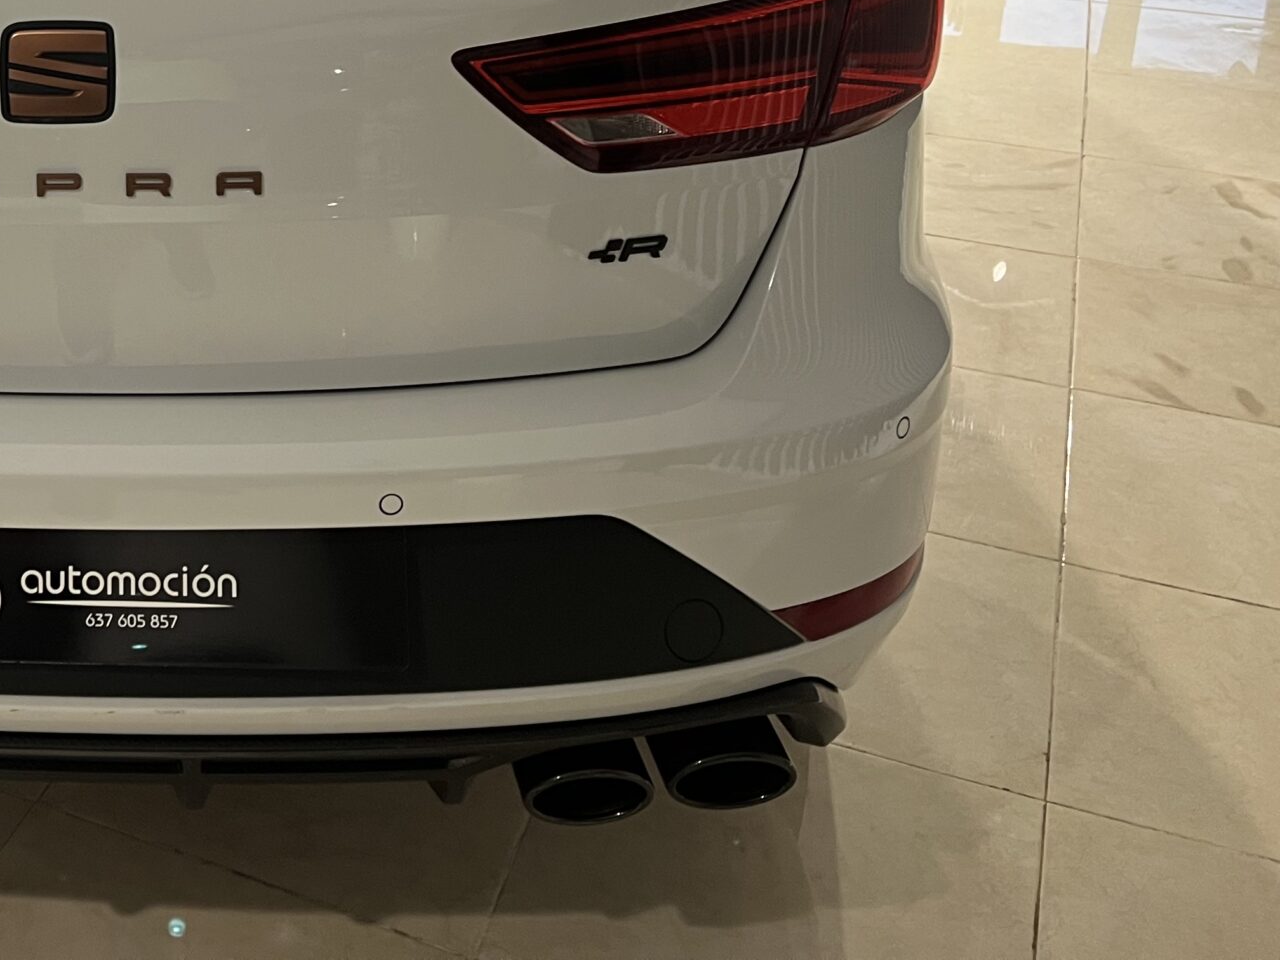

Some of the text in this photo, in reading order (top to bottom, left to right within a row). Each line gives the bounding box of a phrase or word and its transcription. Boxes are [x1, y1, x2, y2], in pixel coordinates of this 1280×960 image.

[20, 564, 238, 598] automoción
[85, 613, 179, 629] 637 605 857
